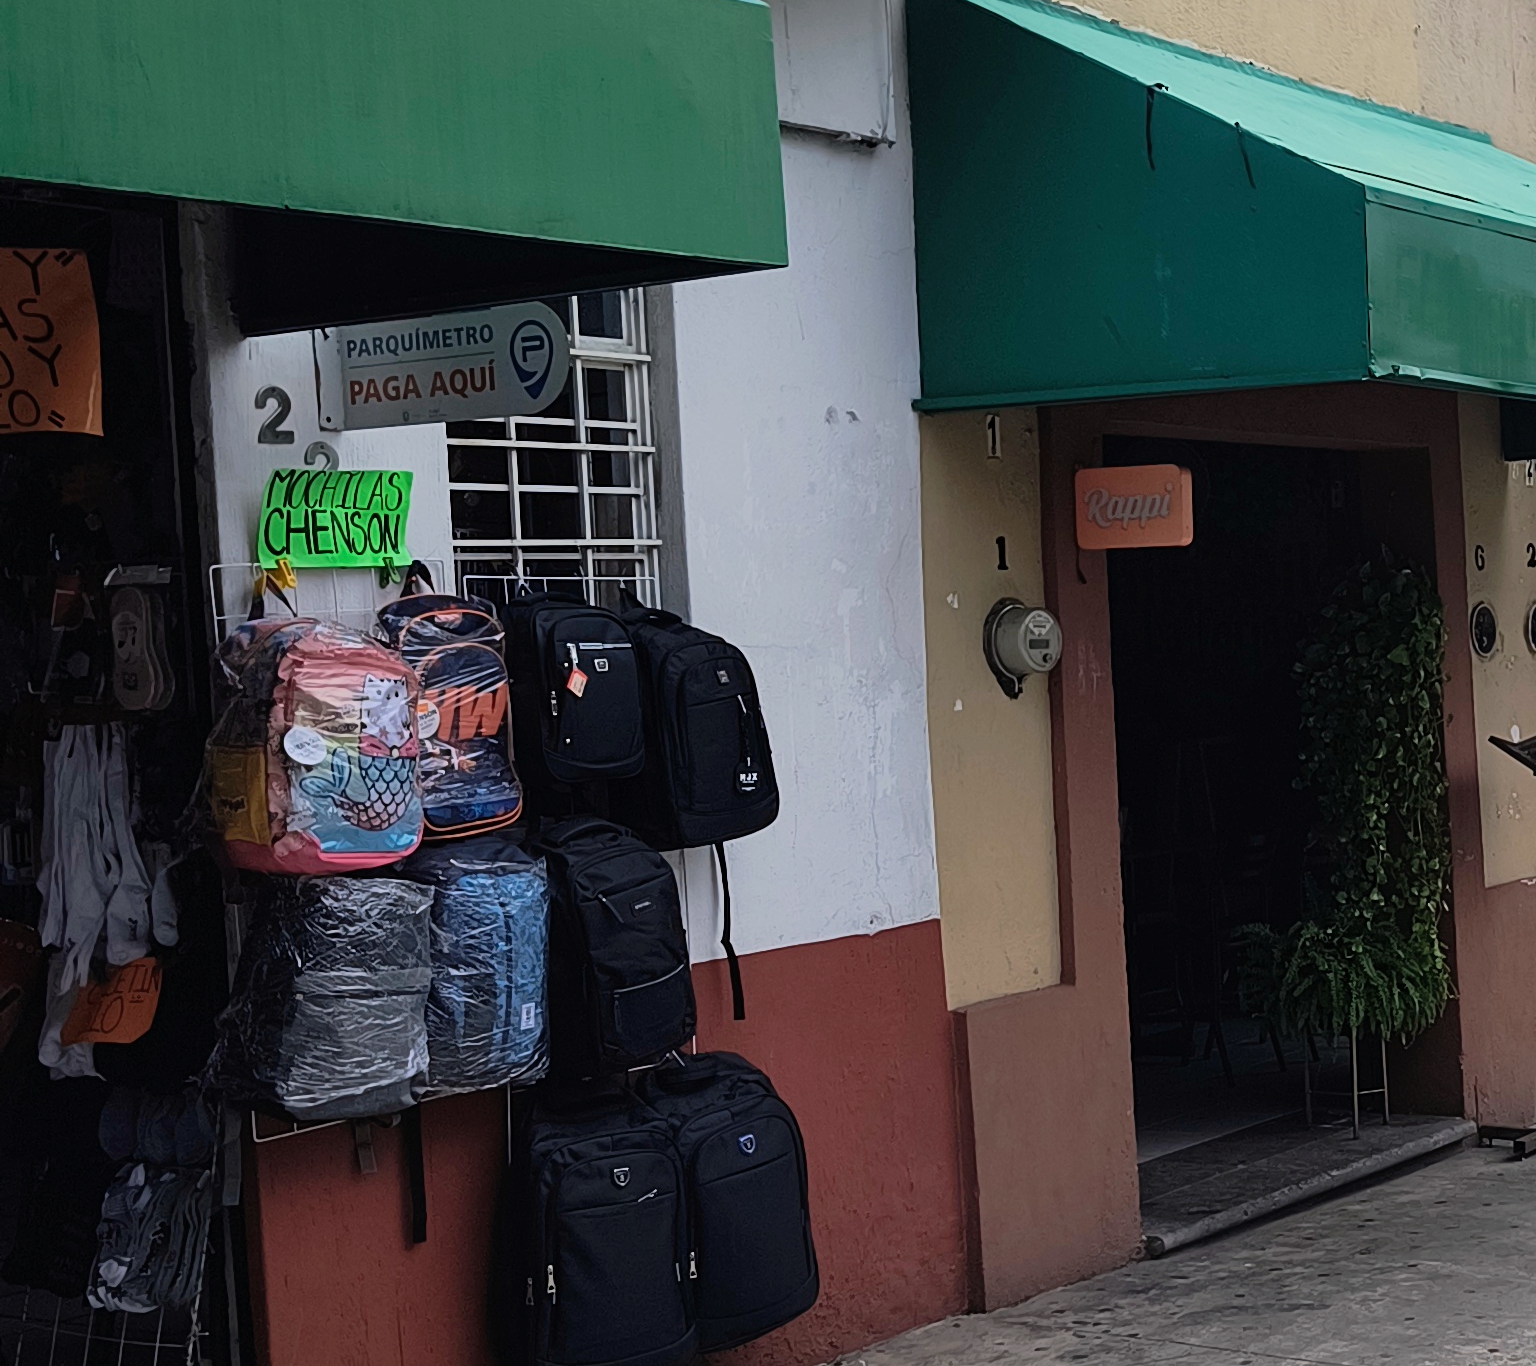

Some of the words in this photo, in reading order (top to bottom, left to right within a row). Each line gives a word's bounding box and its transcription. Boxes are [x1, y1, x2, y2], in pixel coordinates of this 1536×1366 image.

[346, 324, 493, 358] PARQUÍMETRO
[350, 373, 422, 405] PAGA
[430, 359, 496, 399] AQUÍ
[254, 385, 295, 444] 2
[266, 469, 402, 511] MOCHILAS
[1084, 482, 1173, 530] Rappi
[264, 508, 401, 555] CHENSON
[995, 536, 1009, 570] 1
[1526, 543, 1536, 567] 2
